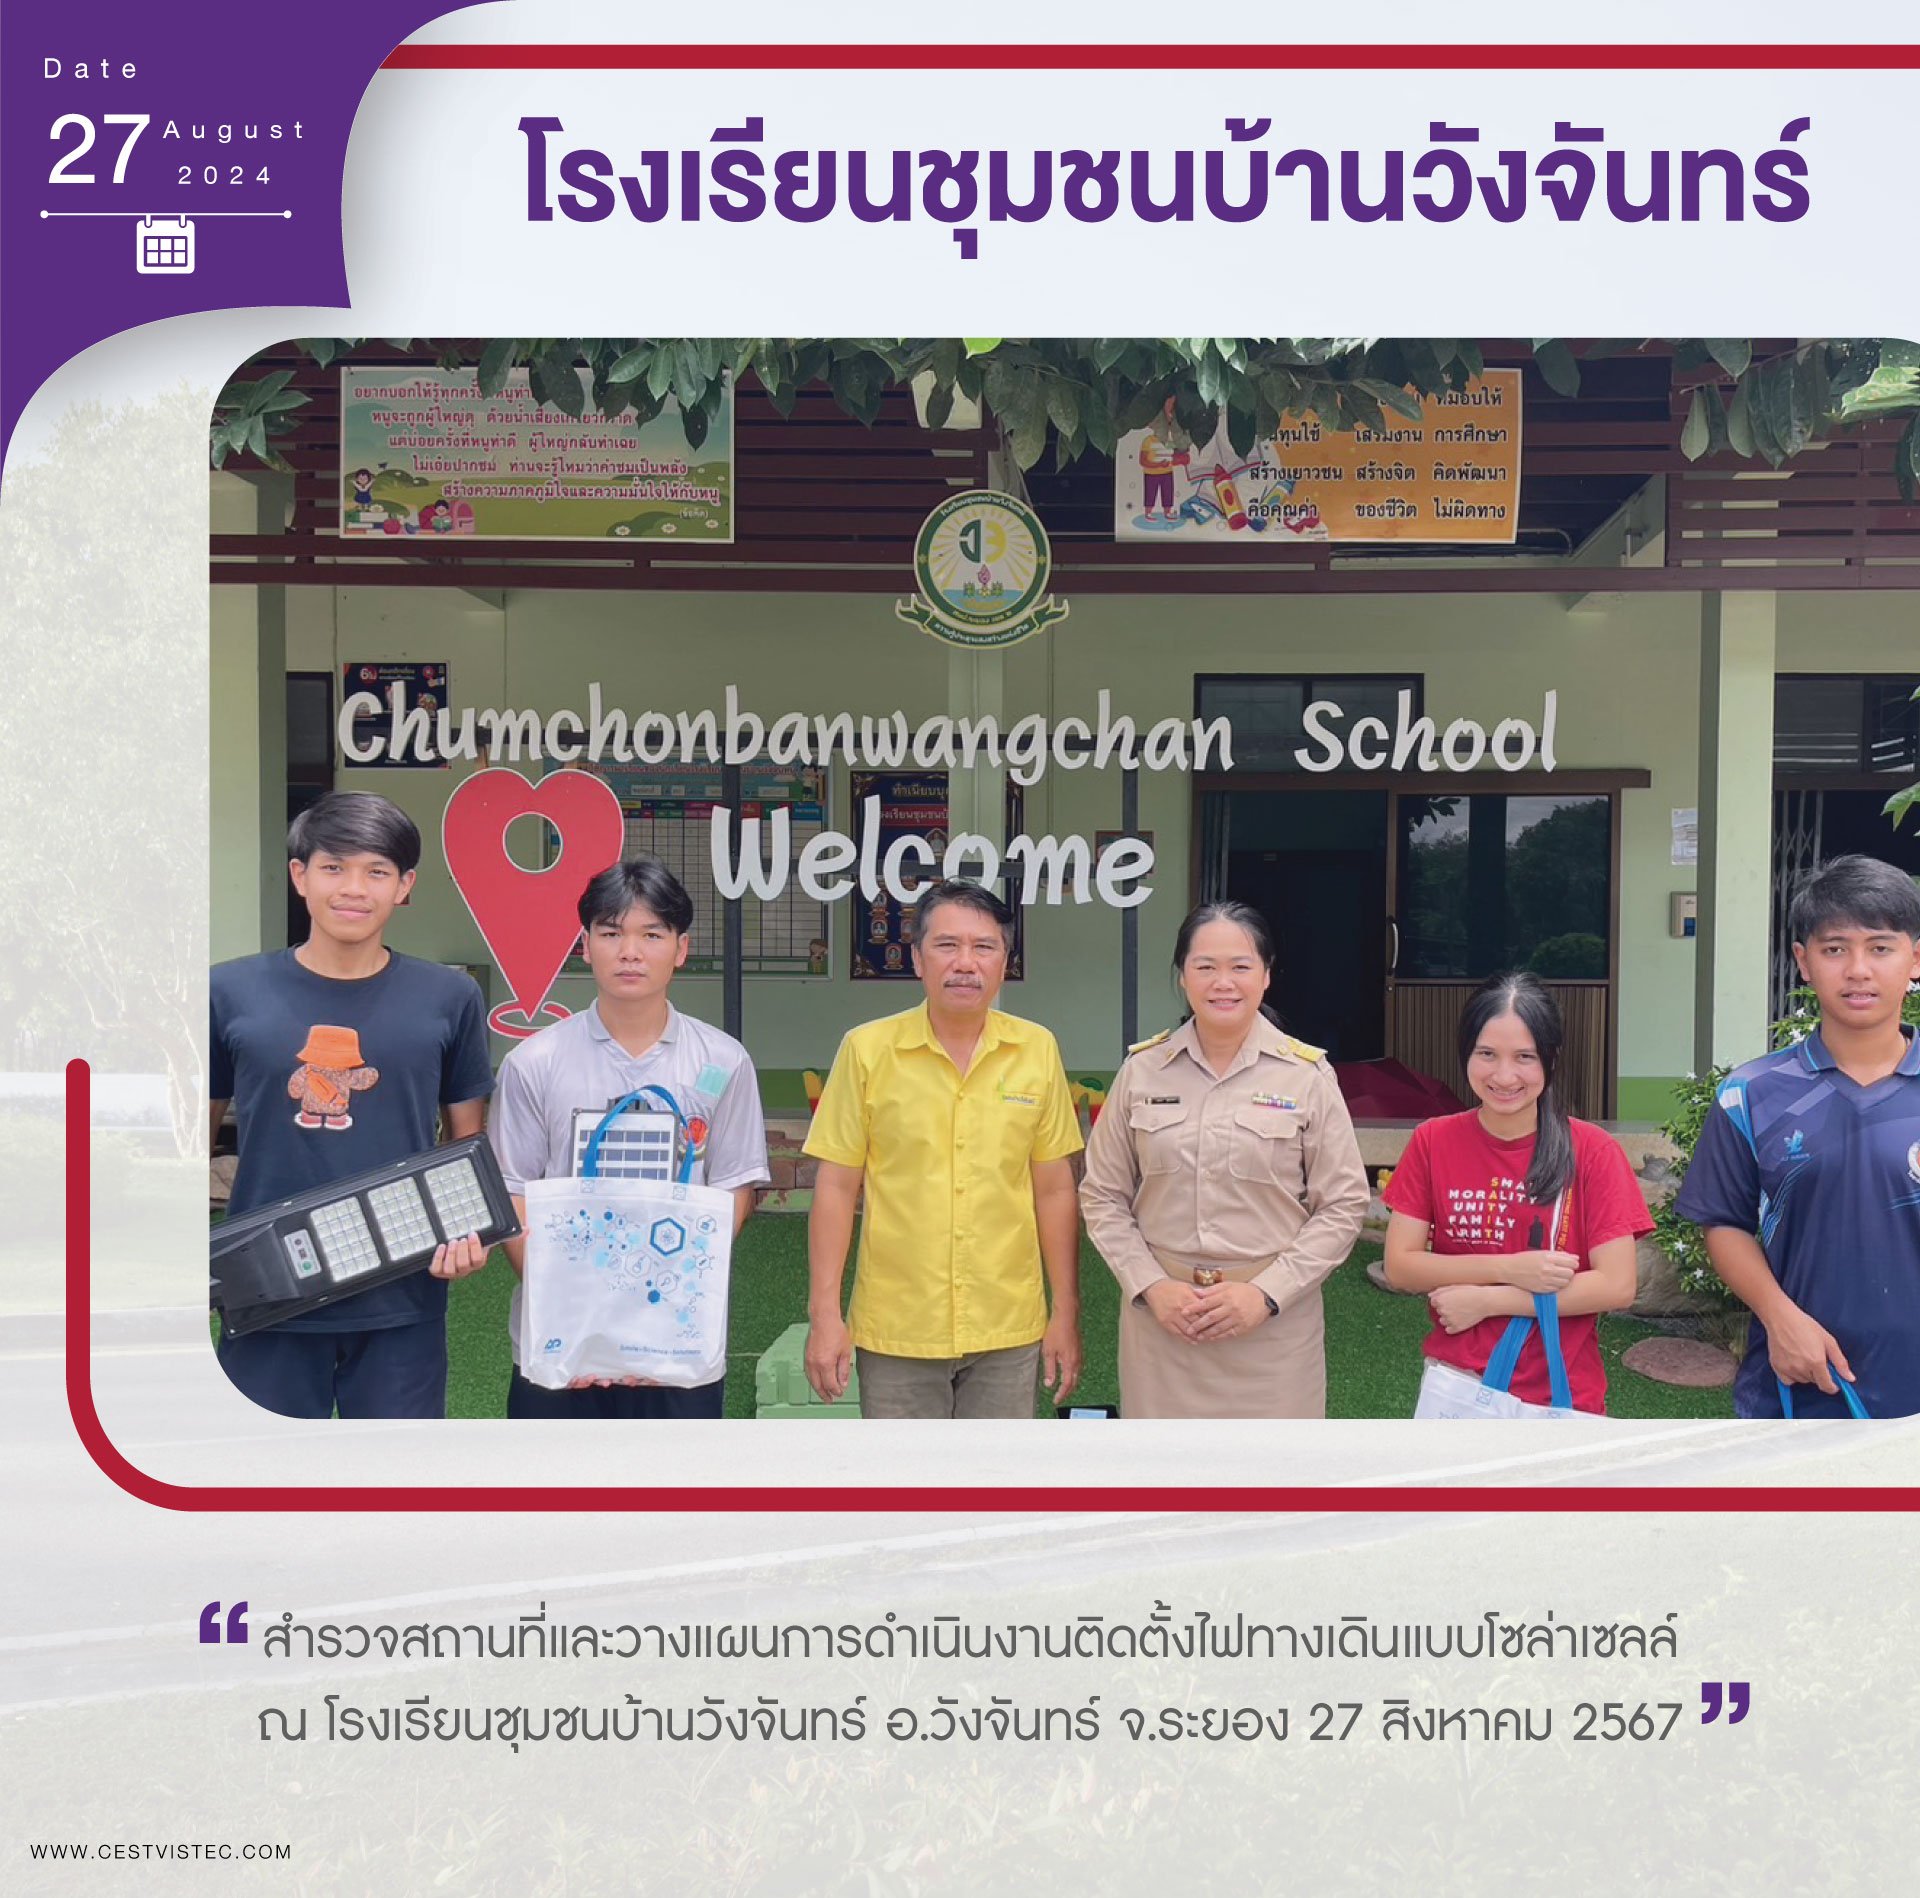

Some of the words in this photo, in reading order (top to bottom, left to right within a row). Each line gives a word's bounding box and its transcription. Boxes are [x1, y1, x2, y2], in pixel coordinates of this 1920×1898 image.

[1434, 423, 1507, 443] การศึกษา
[1249, 461, 1343, 481] สร้างเยาวชน
[1356, 461, 1416, 481] สร้างจิต
[1432, 461, 1507, 481] คิดพัฒนา
[1247, 497, 1318, 523] คือคุณค่า
[1355, 498, 1418, 519] ของชีวิต
[1432, 496, 1506, 520] ไม่ผิดทาง
[338, 681, 1234, 786] Chumchonbanwangchan
[1295, 688, 1559, 774] School
[892, 782, 950, 801] ทำเนียบบุ
[712, 795, 1155, 908] Welcome
[1491, 1177, 1534, 1190] SMA
[1449, 1189, 1538, 1204] MORALITY
[1453, 1202, 1507, 1213] UNITY
[1448, 1215, 1516, 1228] FAMILY
